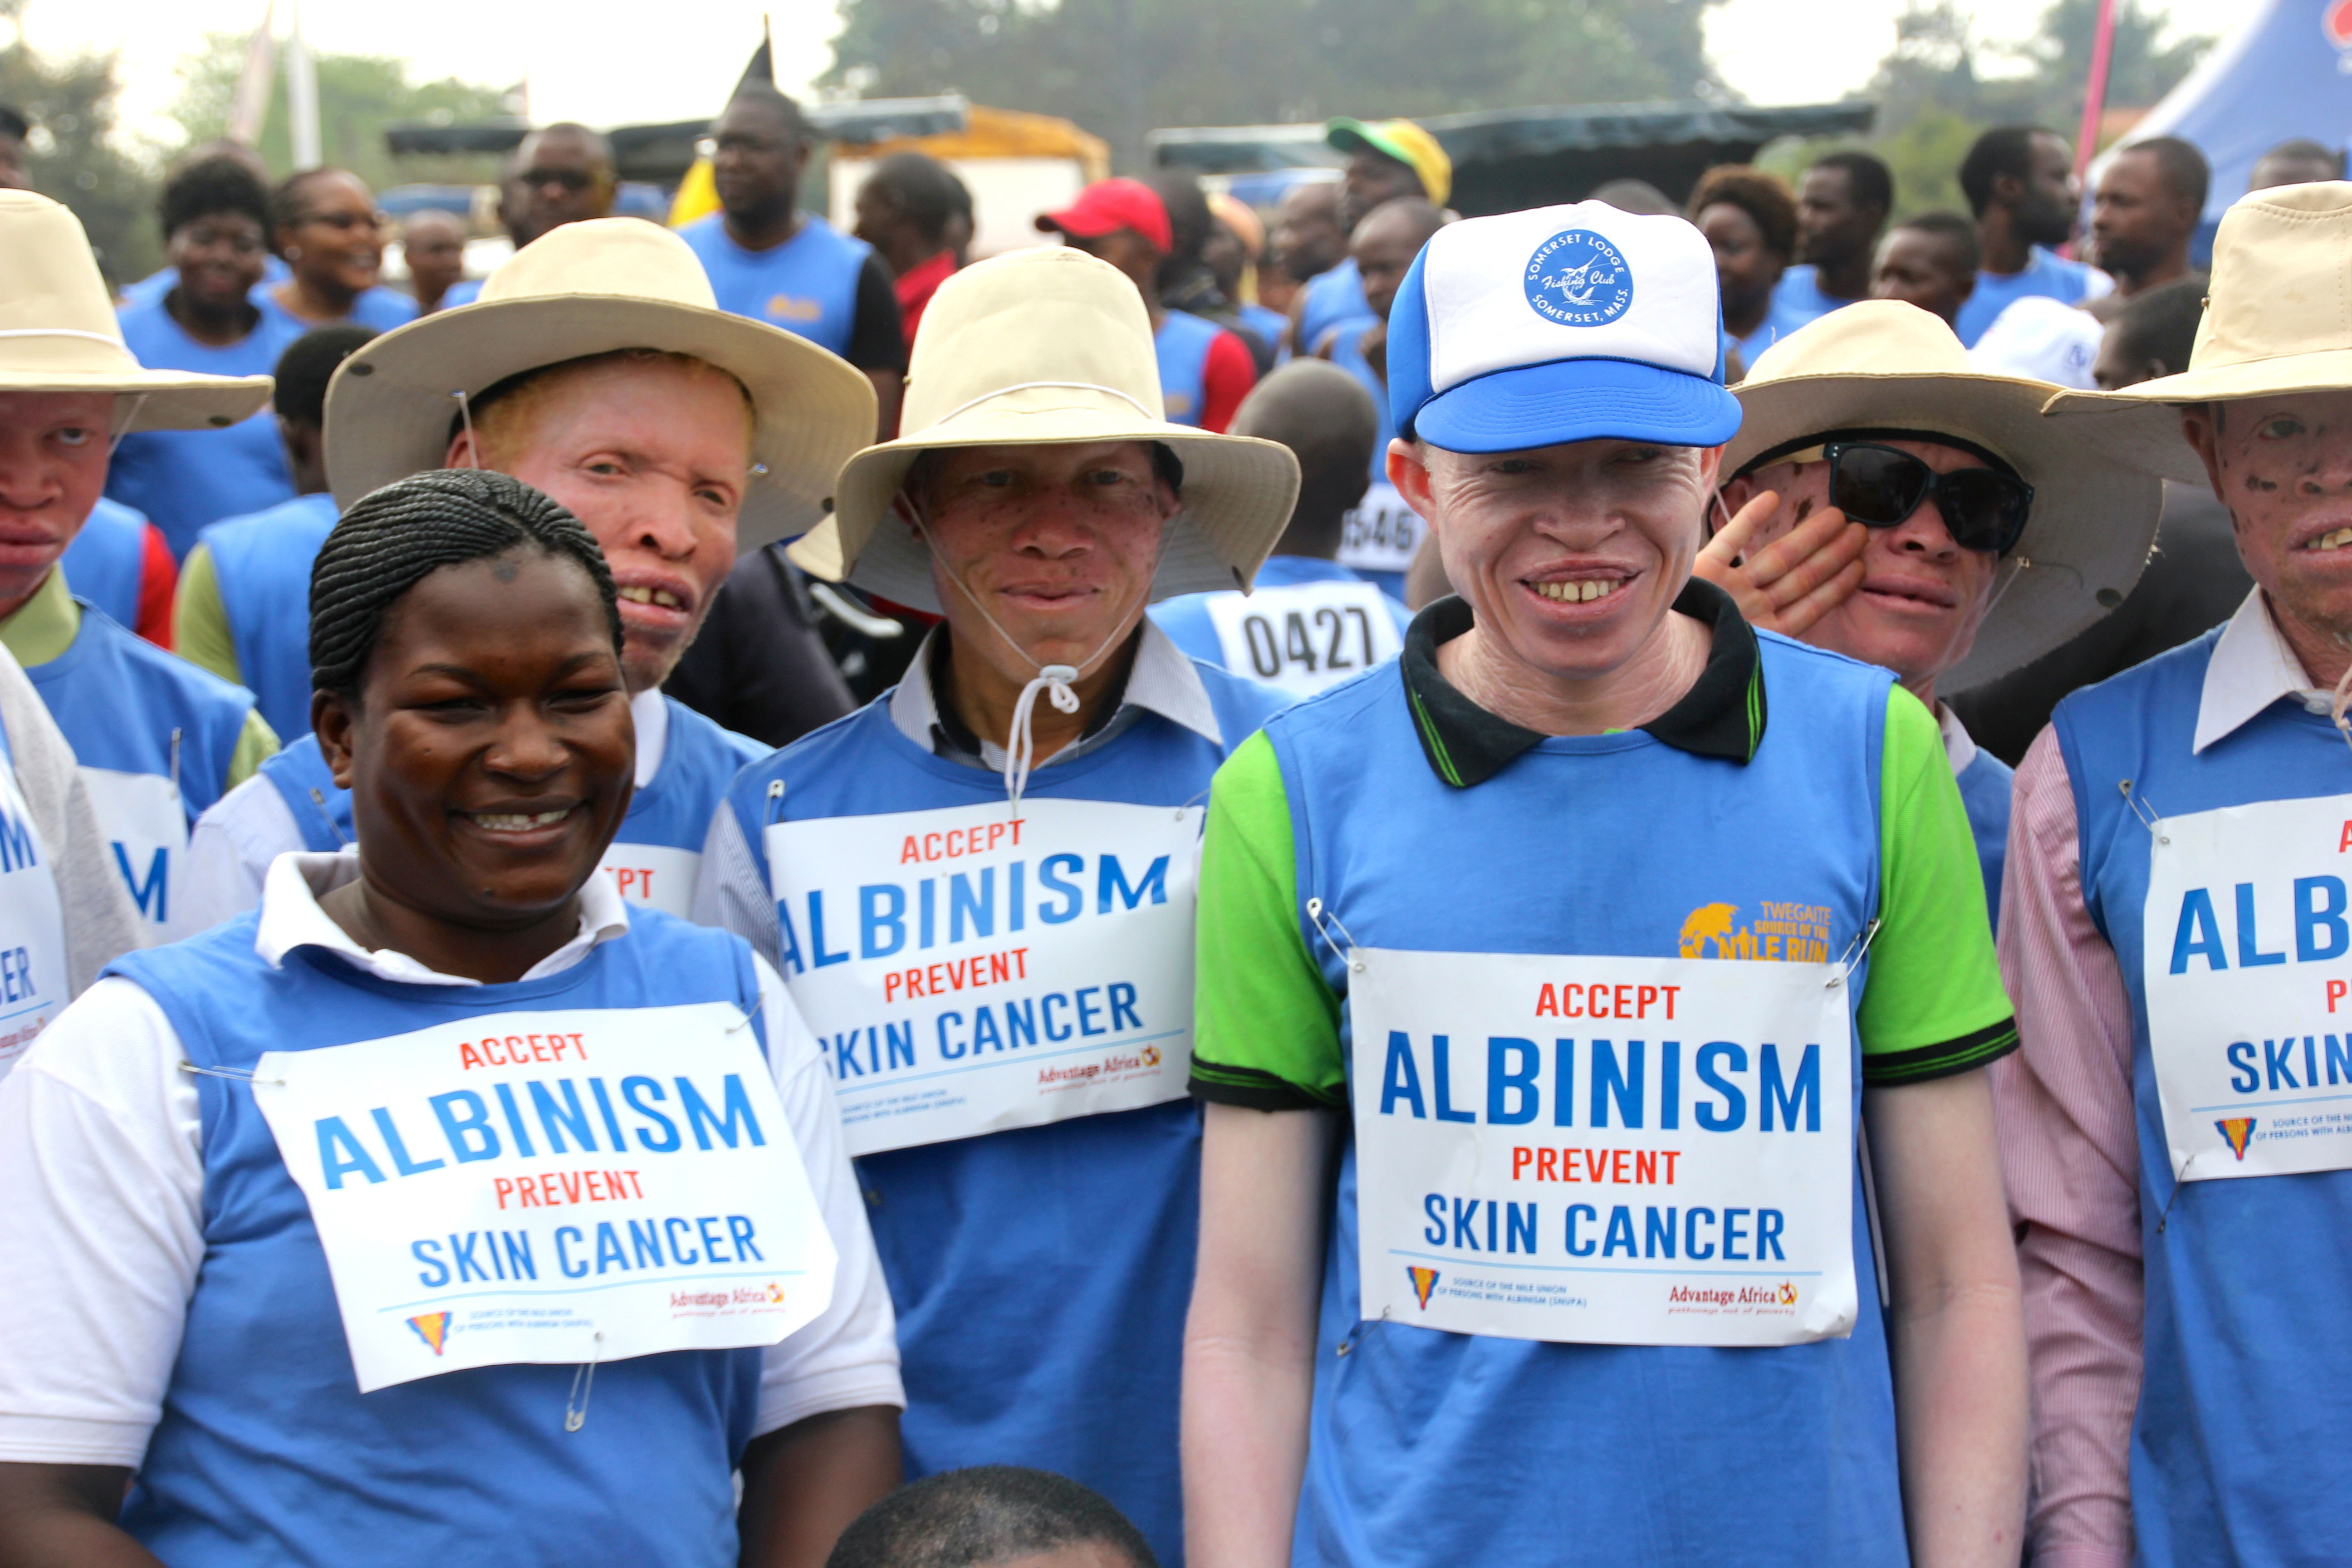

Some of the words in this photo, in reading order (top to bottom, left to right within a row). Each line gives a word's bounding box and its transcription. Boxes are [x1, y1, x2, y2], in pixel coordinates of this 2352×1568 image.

[1528, 234, 1581, 280] SOMERSET
[1588, 236, 1625, 273] LODGE
[1542, 275, 1585, 290] Fishing
[1590, 270, 1615, 284] Club
[1532, 294, 1603, 322] SOMERSET,
[1604, 289, 1628, 317] MASS.
[1245, 607, 1373, 677] 0427
[901, 819, 1025, 864] ACCEPT
[776, 853, 1171, 975] ALBINISM
[1754, 920, 1798, 936] SOURCE
[1799, 922, 1812, 937] OF
[1814, 925, 1829, 940] THE
[1760, 901, 1832, 926] TWEGAITE
[1786, 936, 1829, 964] RUN
[885, 948, 1028, 1002] PREVENT
[936, 981, 1143, 1061] CANCER
[1535, 983, 1681, 1020] ACCEPT
[460, 1034, 587, 1070] ACCEPT
[1380, 1031, 1821, 1133] ALBINISM
[314, 1073, 767, 1190] ALBINISM
[1513, 1147, 1681, 1185] PREVENT
[494, 1170, 643, 1210] PREVENT
[1425, 1194, 1538, 1254] SKIN
[1565, 1204, 1786, 1261] CANCER
[411, 1230, 538, 1288] SKIN
[554, 1215, 764, 1279] CANCER
[1669, 1284, 1735, 1307] Advantage
[1738, 1286, 1776, 1303] Africa
